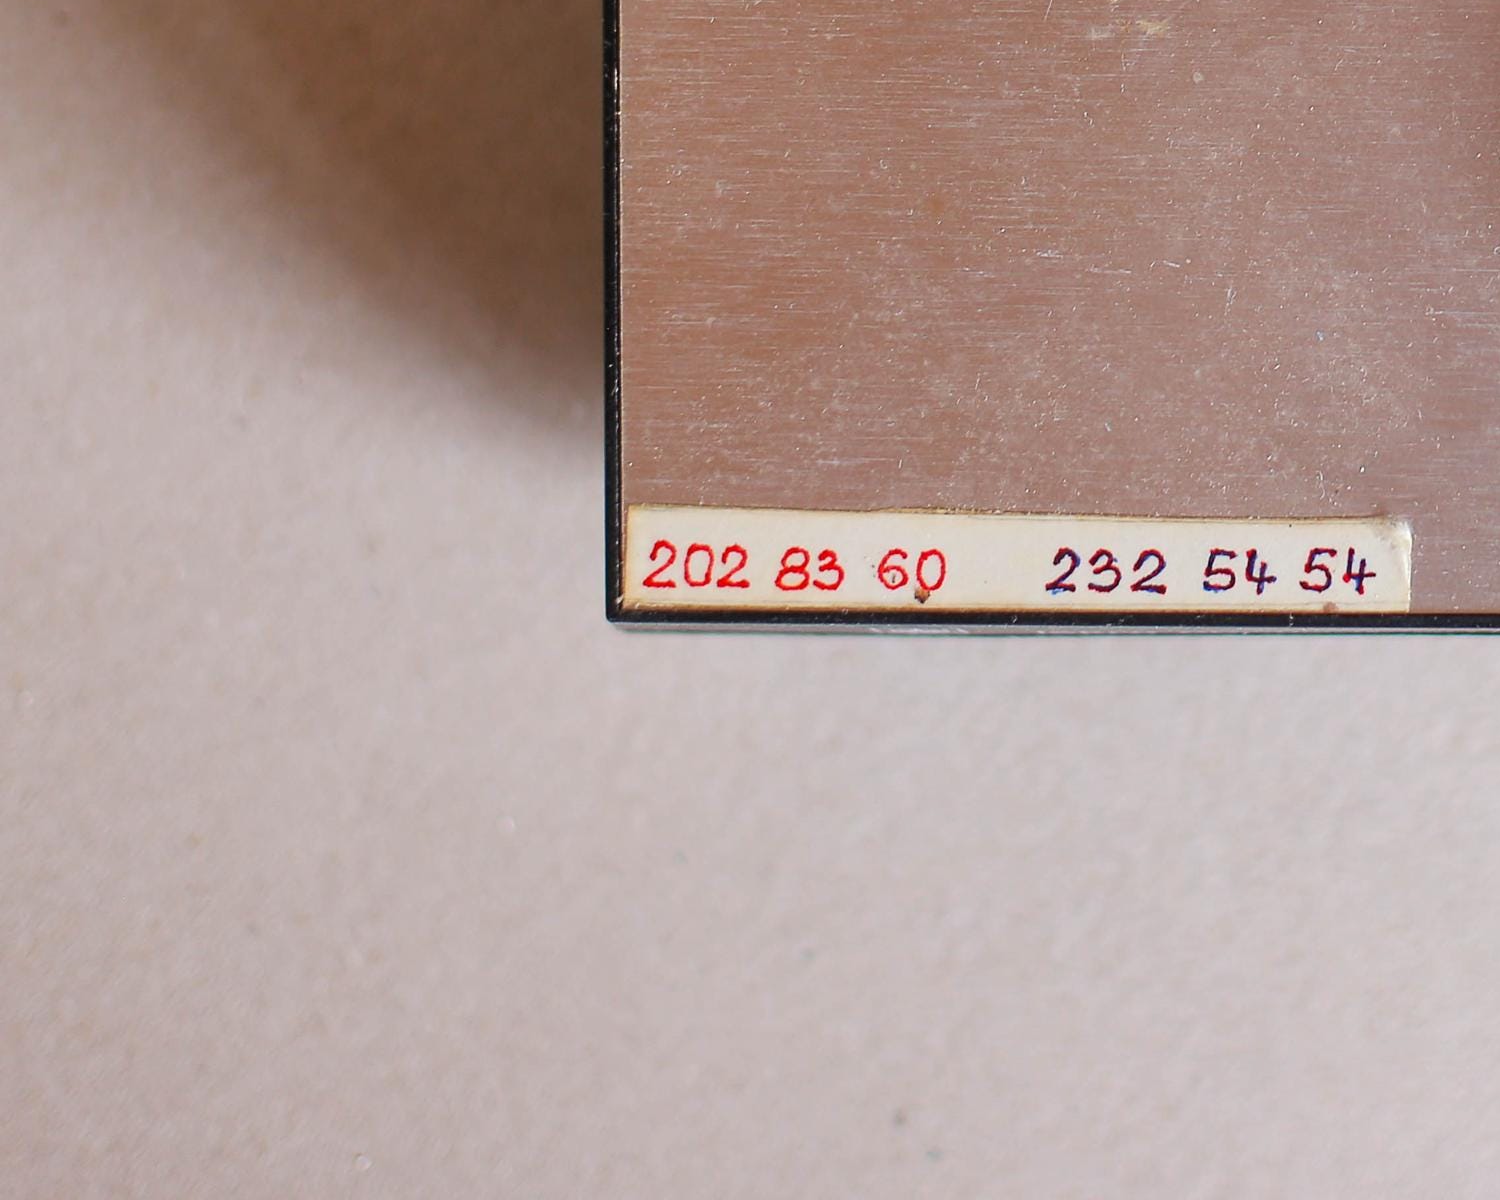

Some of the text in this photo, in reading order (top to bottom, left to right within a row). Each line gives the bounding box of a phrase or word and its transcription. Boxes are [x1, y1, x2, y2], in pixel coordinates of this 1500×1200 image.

[641, 539, 946, 592] 202 83 60
[1045, 547, 1376, 596] 232 54 54
